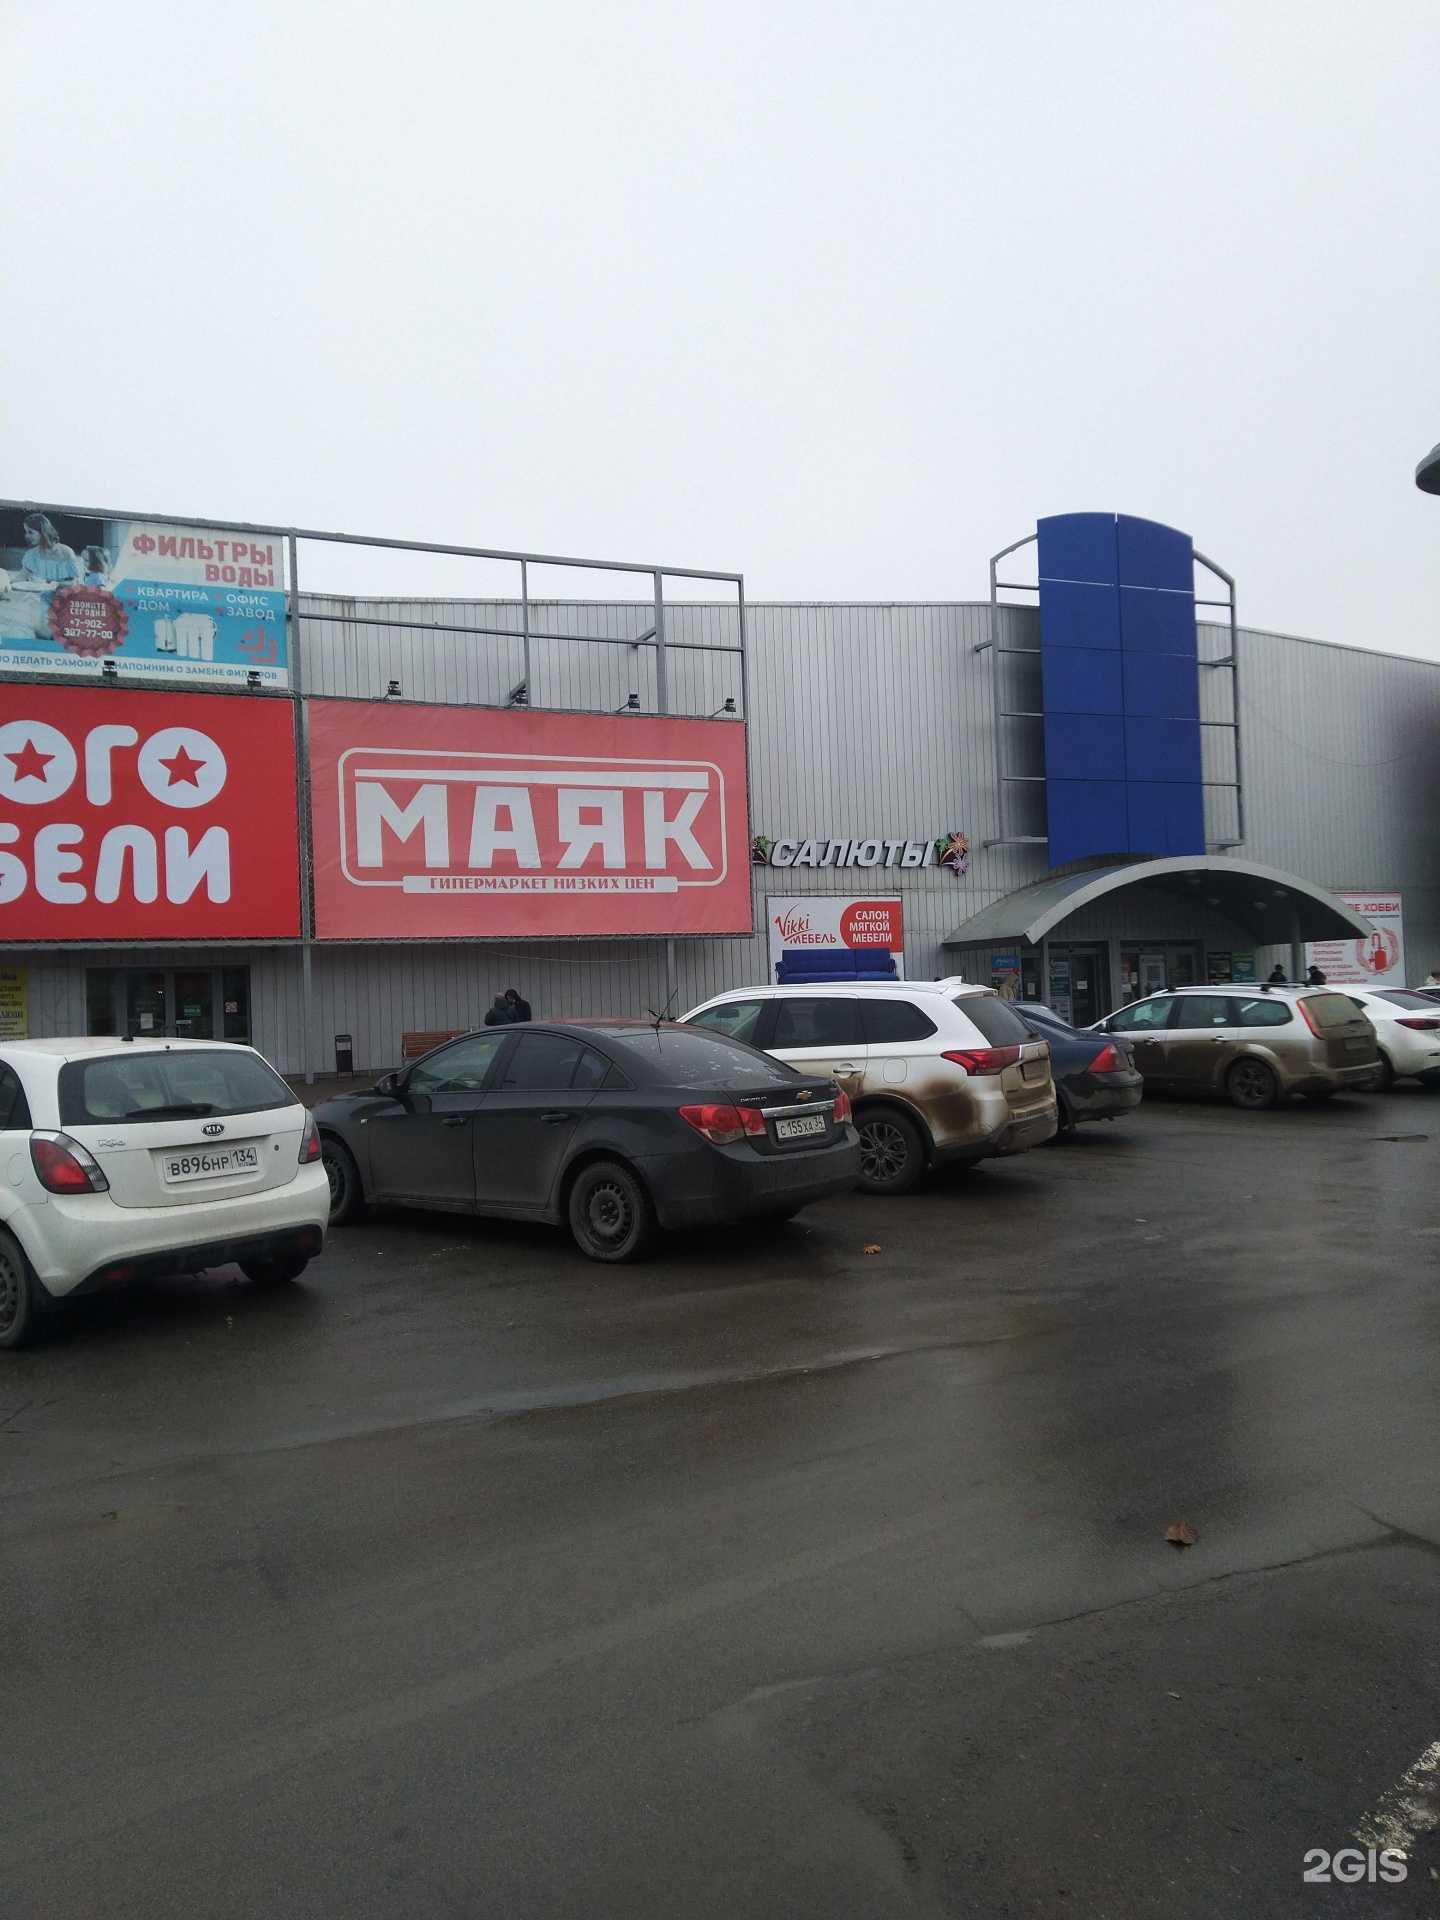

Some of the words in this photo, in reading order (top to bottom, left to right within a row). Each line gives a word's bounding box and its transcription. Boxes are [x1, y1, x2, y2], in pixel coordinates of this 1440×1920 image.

[132, 533, 273, 566] ФИЛЬТРЫ
[205, 563, 275, 588] ВОДЫ
[137, 585, 209, 602] КВАРТИРА
[226, 592, 269, 606] ОФИС
[137, 599, 171, 613] ДОМ
[226, 606, 276, 622] ЗАВОД
[12, 655, 53, 667] ДЕЛАТЬ
[54, 659, 99, 669] САМОМУ
[115, 661, 174, 674] НАПОМНИМ
[176, 665, 184, 674] О
[185, 667, 225, 676] ЗАМЕНЕ
[225, 669, 278, 681] ФИЛРОВ
[354, 782, 714, 870] МАЯК
[770, 838, 937, 868] САЛЮТЫ
[429, 877, 549, 890] ГИПЕРМАРКЕТ
[553, 878, 620, 890] НИЗКИХ
[624, 878, 656, 890] ЦЕН
[855, 910, 890, 920] САЛОН
[1363, 903, 1400, 912] ХОББИ
[774, 904, 810, 937] Vikki
[849, 920, 890, 931] МЯГКОЙ
[788, 933, 837, 944] МЕБЕЛЬ
[852, 933, 893, 943] МЕБЕЛИ
[170, 1155, 230, 1177] В896НР
[232, 1149, 254, 1163] 134
